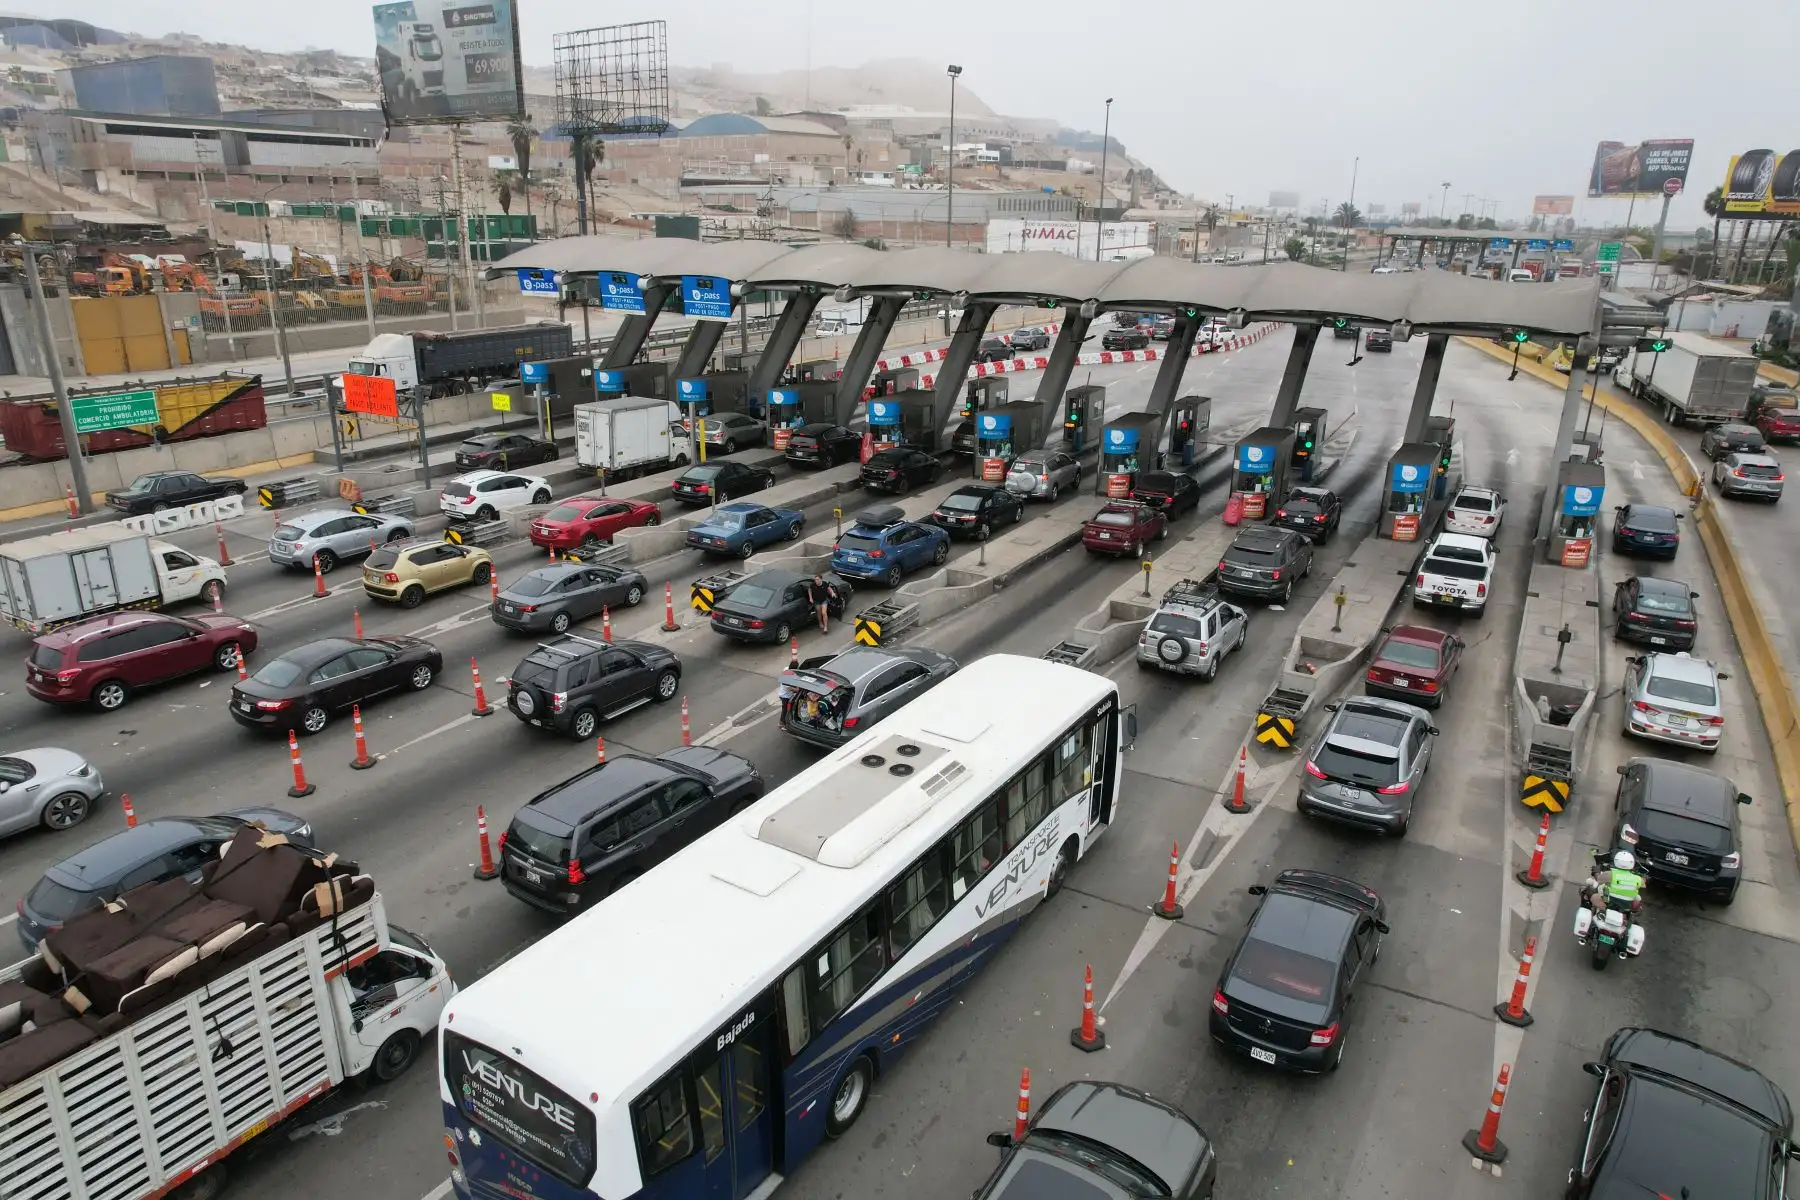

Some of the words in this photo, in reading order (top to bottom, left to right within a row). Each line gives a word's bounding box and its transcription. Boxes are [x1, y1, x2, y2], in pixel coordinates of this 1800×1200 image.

[475, 58, 508, 74] 69,900
[1022, 227, 1077, 240] RIMAC
[524, 280, 554, 290] e-pass
[609, 284, 634, 295] e-pass
[692, 290, 721, 301] e-pass
[99, 404, 132, 413] PROHIBIDO
[113, 409, 154, 419] AMBULATORIO
[78, 415, 110, 424] COMERCIO
[1432, 584, 1467, 595] TOYOTA
[975, 823, 1060, 919] VENTURE
[717, 1011, 755, 1051] Bajada
[462, 1049, 575, 1133] VENTURE
